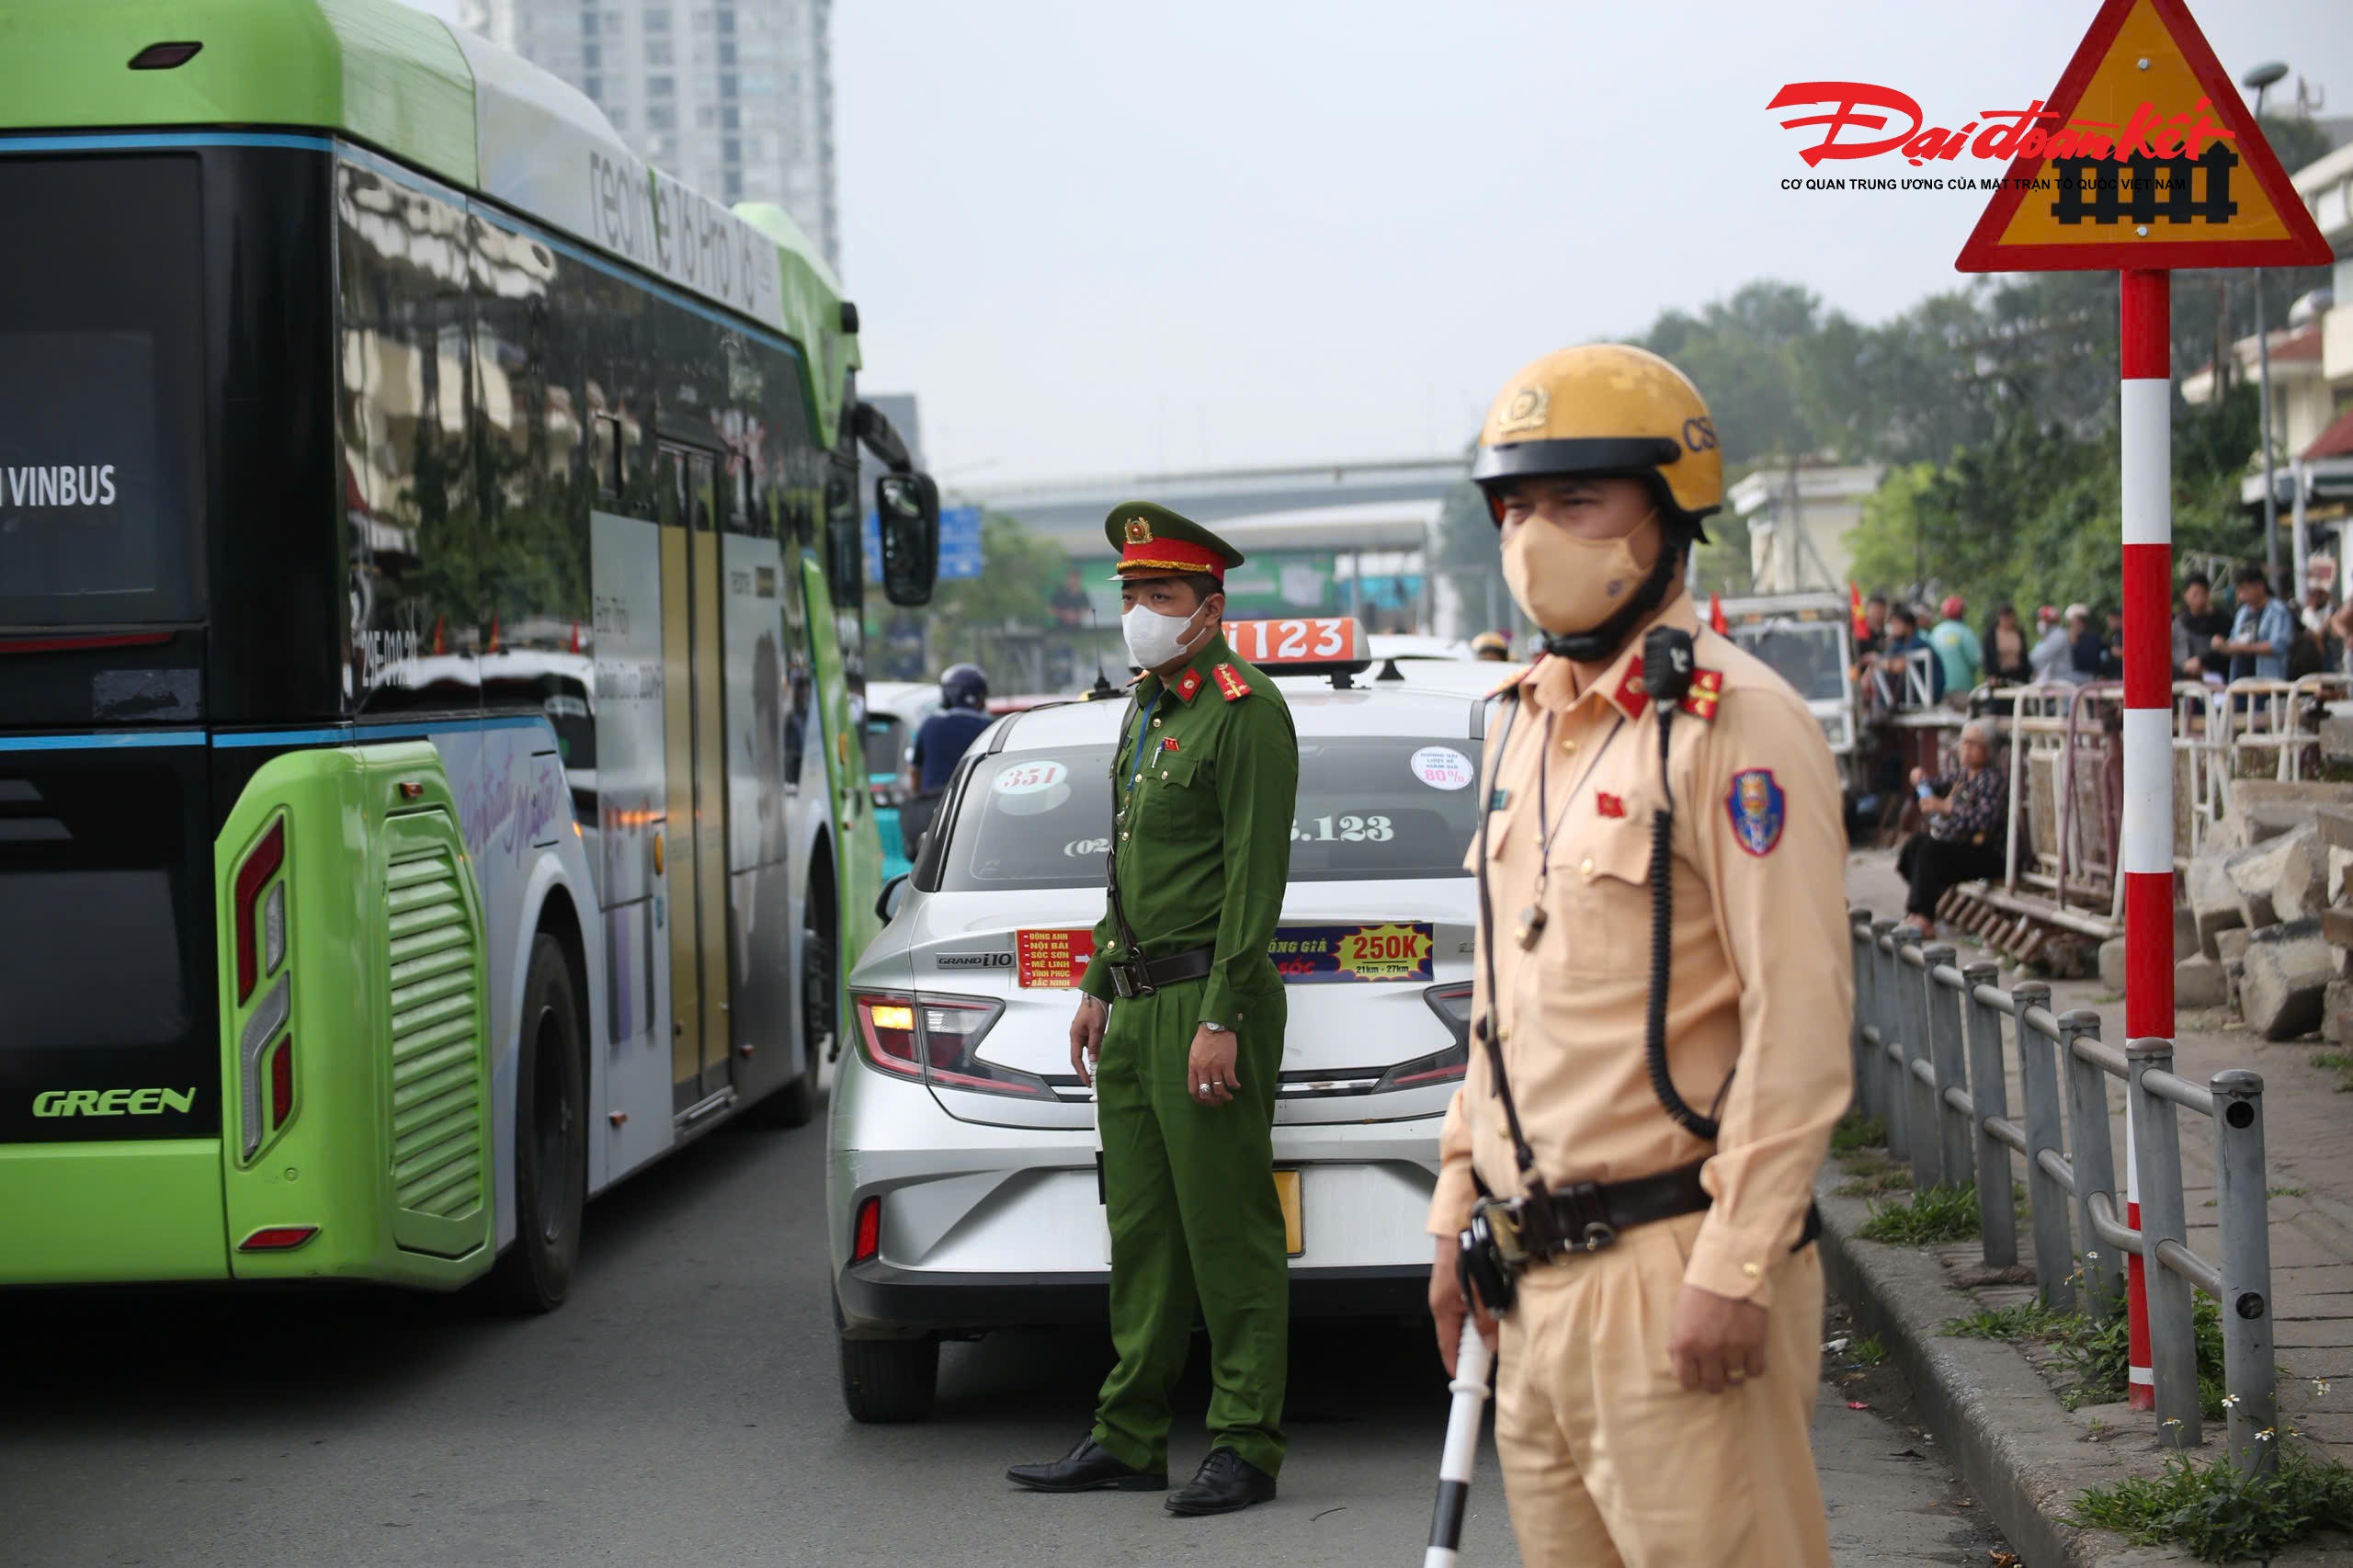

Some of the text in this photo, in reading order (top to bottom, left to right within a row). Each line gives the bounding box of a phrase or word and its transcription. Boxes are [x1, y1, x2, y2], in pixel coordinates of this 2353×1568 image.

[7, 463, 117, 506] VINBUS
[1253, 619, 1344, 659] 123
[1425, 769, 1464, 782] 80%
[1030, 941, 1069, 950] NỘI BÀI
[1267, 937, 1298, 953] ỒNG
[1352, 935, 1418, 960] 250K
[938, 953, 1011, 967] GRAND i10
[1356, 965, 1379, 973] 21km
[1386, 965, 1409, 973] 27km
[32, 1086, 197, 1118] GREEN
